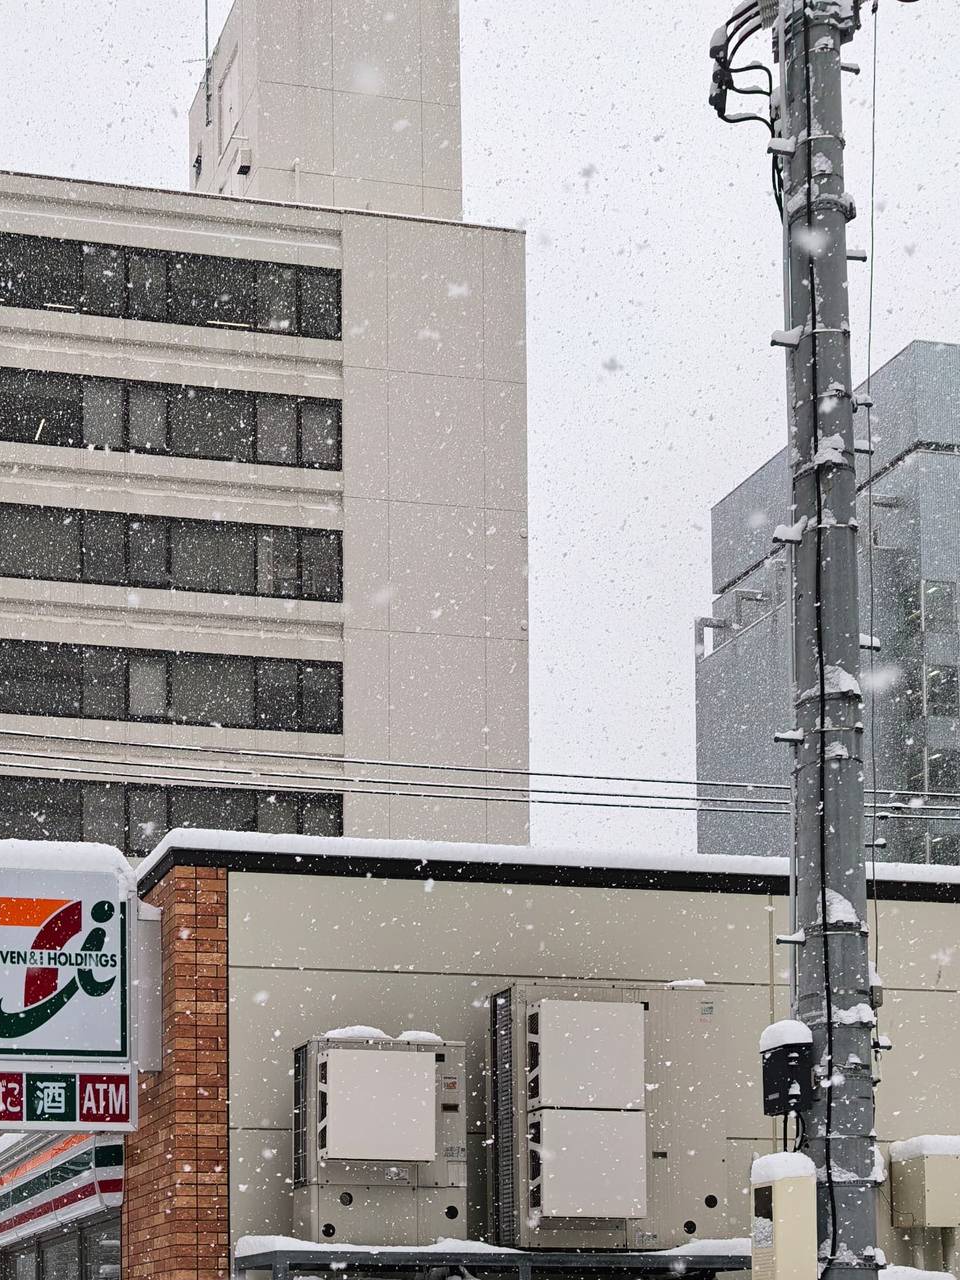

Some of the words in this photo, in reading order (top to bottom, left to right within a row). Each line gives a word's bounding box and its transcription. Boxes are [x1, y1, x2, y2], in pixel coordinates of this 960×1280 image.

[47, 952, 117, 967] HOLDINGS
[36, 1081, 66, 1115] 酒
[82, 1083, 126, 1115] ATM
